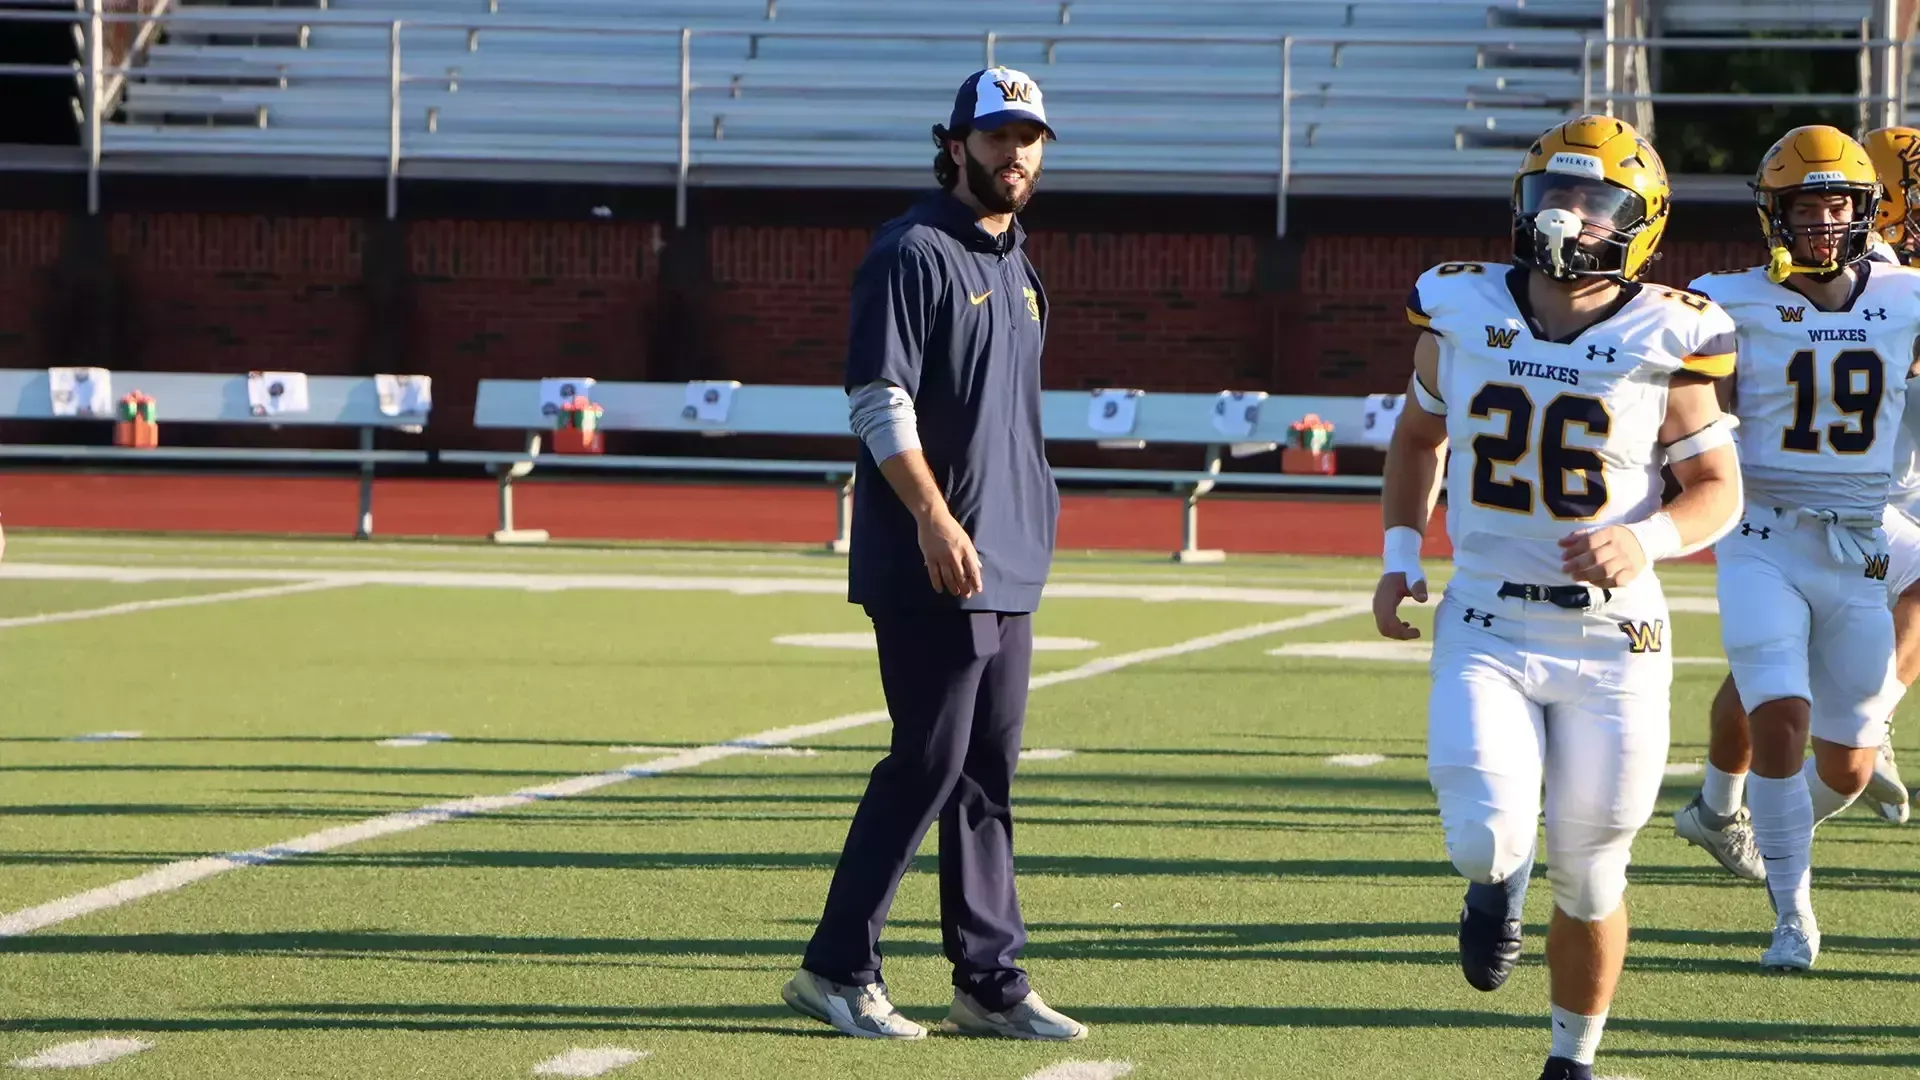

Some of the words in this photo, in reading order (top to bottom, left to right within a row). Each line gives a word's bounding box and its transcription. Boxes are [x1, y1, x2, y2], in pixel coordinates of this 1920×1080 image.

[1556, 156, 1594, 167] WILKES
[1808, 173, 1842, 181] WILKES
[1776, 305, 1805, 322] W
[1485, 325, 1519, 349] W
[1807, 329, 1867, 342] WILKES
[1508, 359, 1579, 386] WILKES
[1781, 348, 1886, 455] 19
[1468, 380, 1612, 521] 26
[1619, 619, 1663, 653] W
